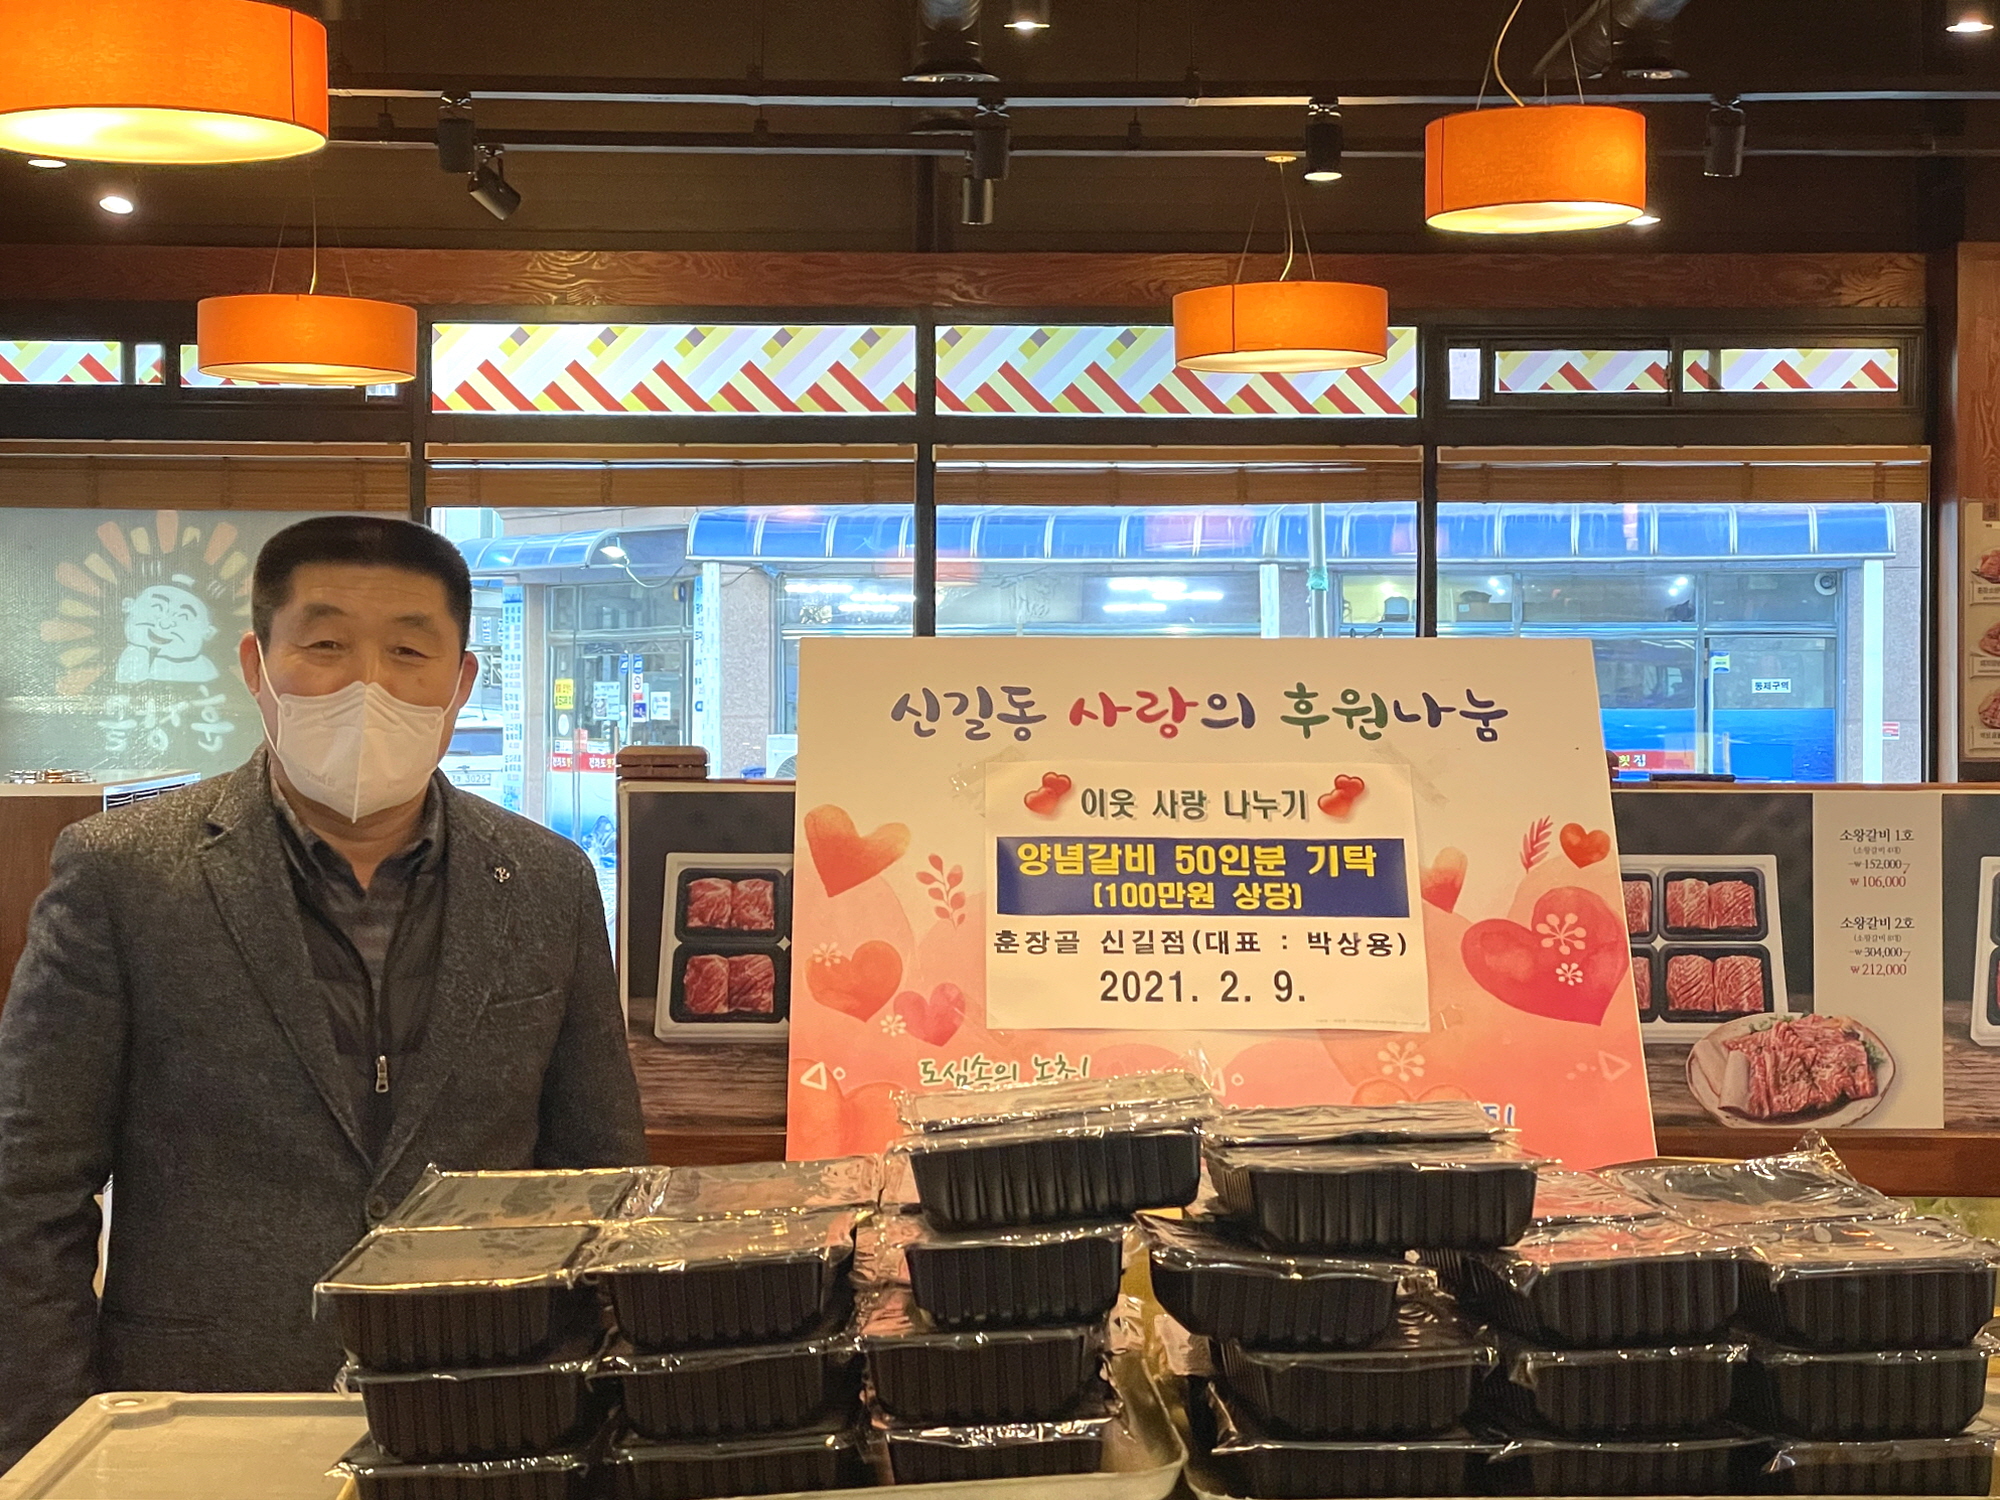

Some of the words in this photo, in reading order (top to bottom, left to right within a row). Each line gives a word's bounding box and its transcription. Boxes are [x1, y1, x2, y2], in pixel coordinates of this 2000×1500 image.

[890, 685, 1047, 742] 신길동
[1069, 686, 1256, 739] 사랑의
[1280, 682, 1509, 742] 후원나눔
[1080, 788, 1136, 819] 이웃
[1151, 789, 1207, 821] 사랑
[1223, 789, 1306, 820] 나누기
[1839, 828, 1890, 843] 소왕갈비
[1895, 829, 1915, 841] 1호
[1017, 842, 1156, 876] 양념갈비
[1174, 844, 1287, 877] 50인분
[1306, 845, 1377, 878] 기탁
[1093, 881, 1216, 909] (100만원
[1232, 882, 1303, 911] 상당)
[1840, 916, 1891, 931] 소왕갈비
[1895, 917, 1916, 929] 2호
[993, 930, 1080, 955] 훈장골
[1100, 929, 1261, 955] 신길점(대표
[1306, 931, 1408, 957] 박상용)
[1100, 969, 1199, 1003] 2021.
[1220, 970, 1252, 1003] 2.
[1273, 969, 1306, 1003] 9.
